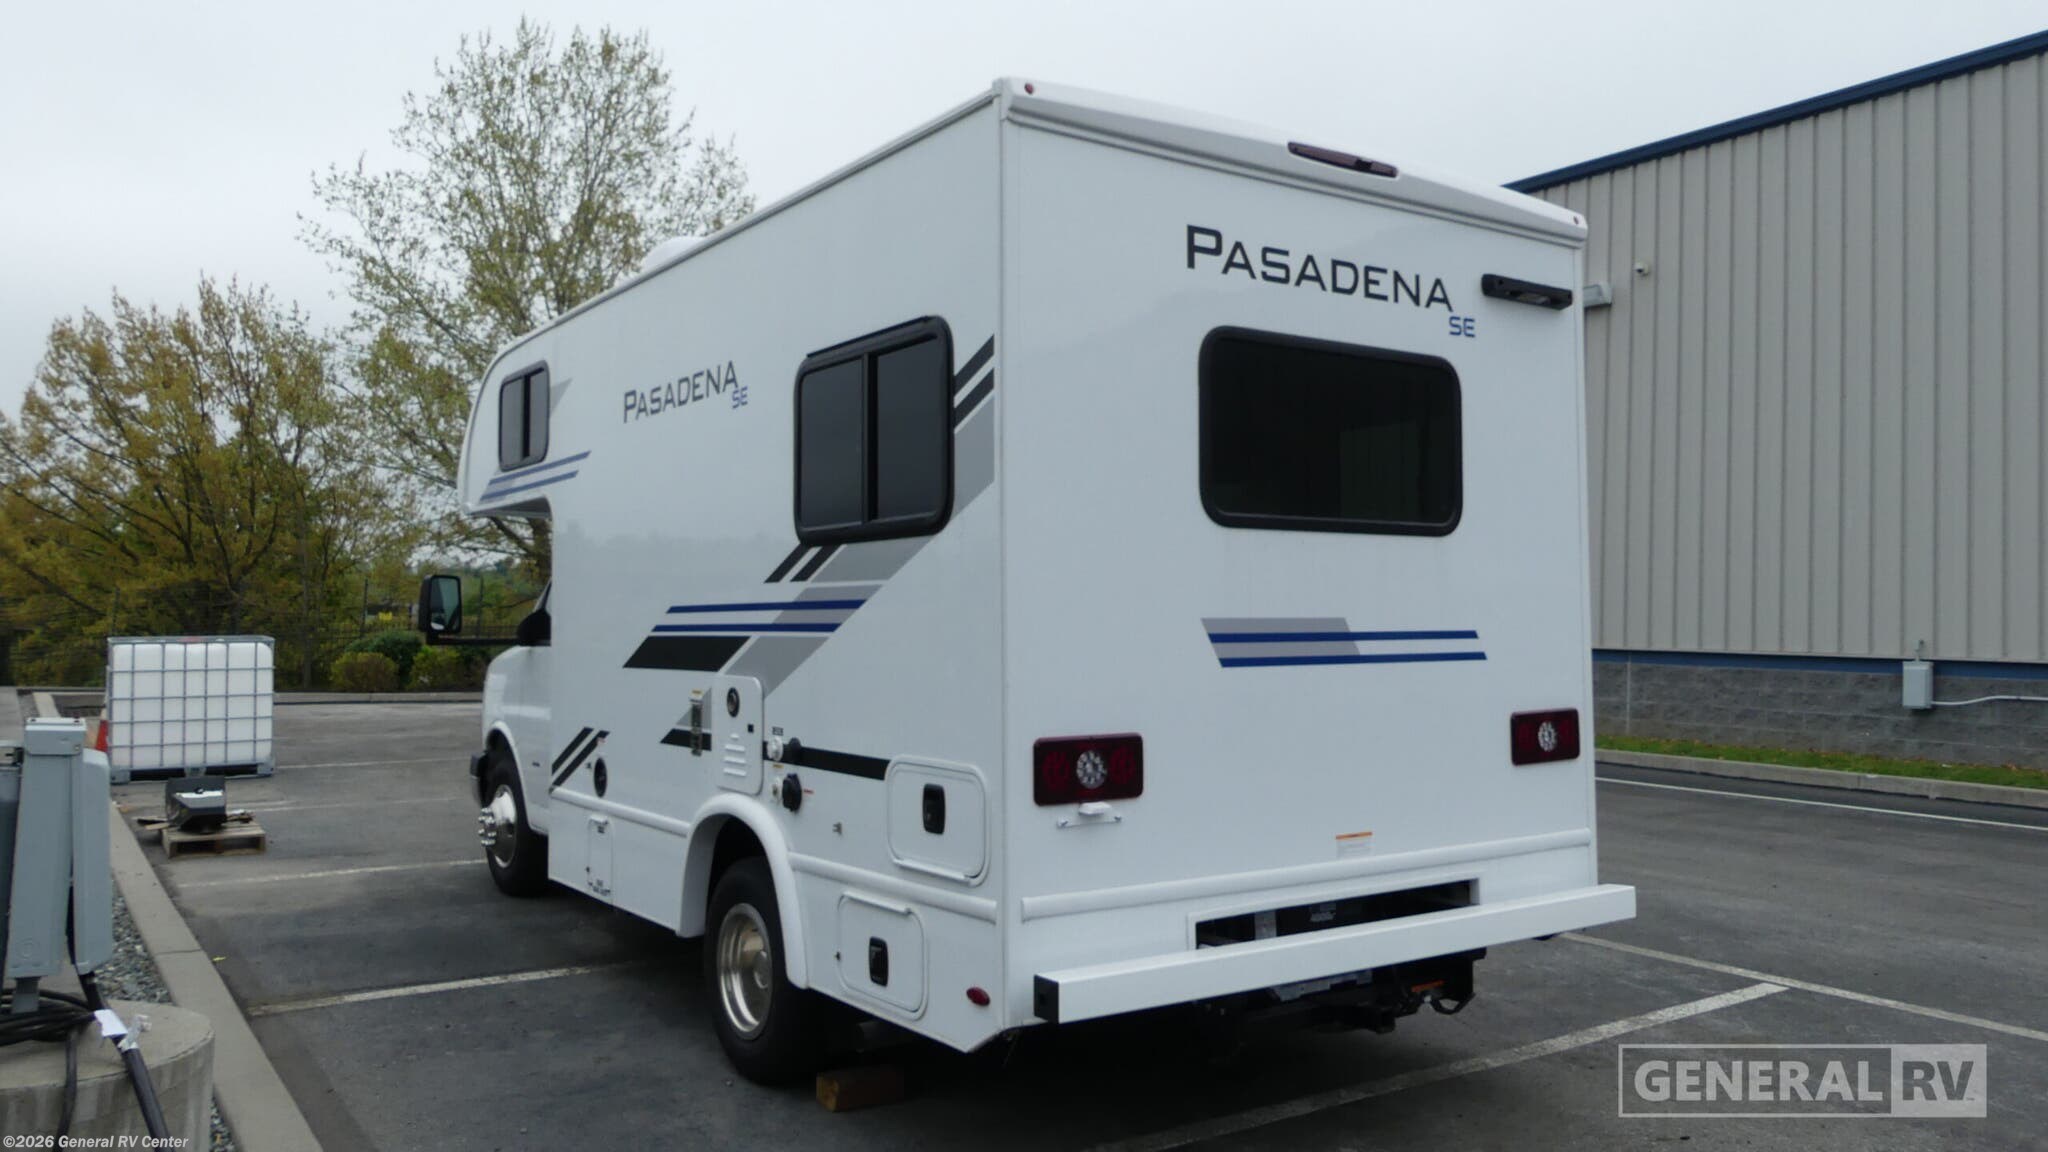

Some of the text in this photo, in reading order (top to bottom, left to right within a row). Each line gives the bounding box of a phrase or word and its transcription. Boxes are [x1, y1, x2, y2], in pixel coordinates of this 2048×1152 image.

[1186, 224, 1454, 313] PASADENA
[1448, 316, 1476, 338] SE
[623, 360, 739, 424] PASADENA
[731, 385, 748, 410] SE
